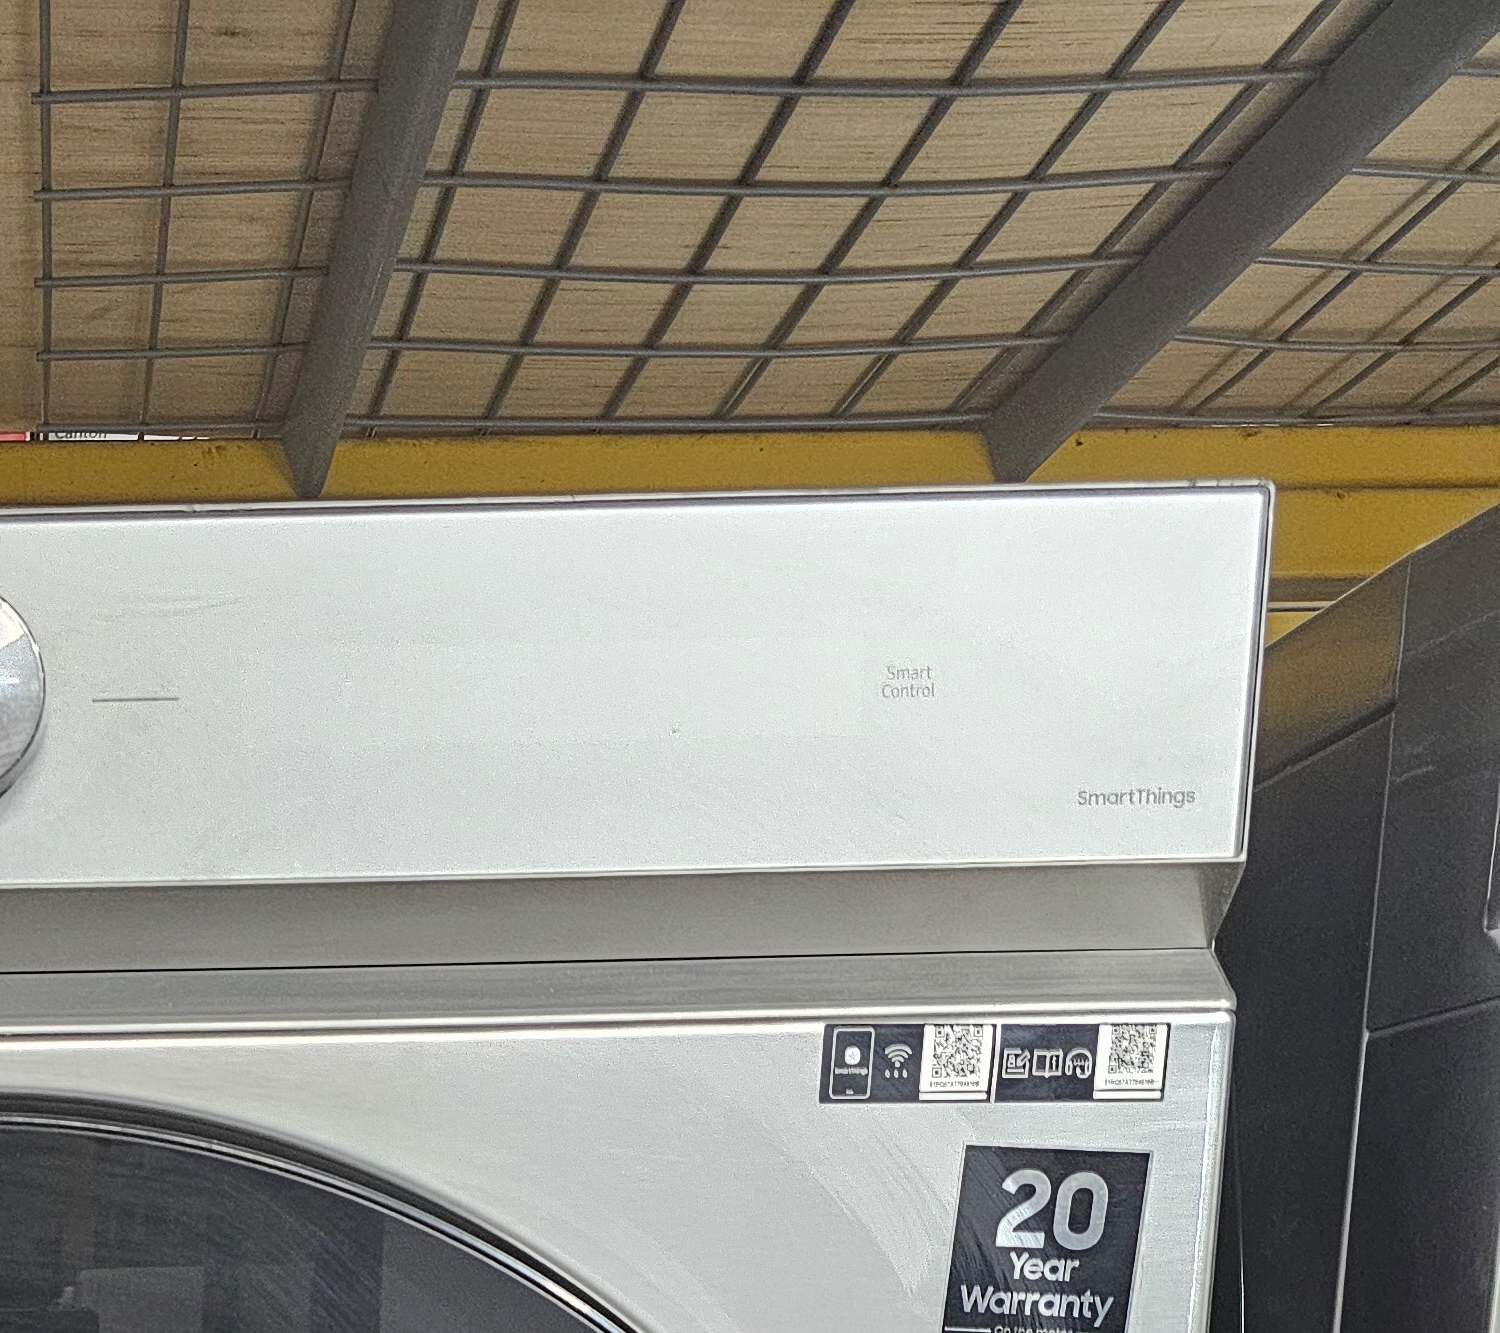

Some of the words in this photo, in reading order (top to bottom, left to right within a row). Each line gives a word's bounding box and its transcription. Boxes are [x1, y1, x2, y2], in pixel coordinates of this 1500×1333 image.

[886, 664, 933, 681] Smart
[881, 683, 935, 699] Control
[1077, 787, 1196, 809] SmartThings
[995, 1168, 1109, 1251] 20
[1010, 1251, 1080, 1282] Year
[960, 1284, 1114, 1328] Warranty
